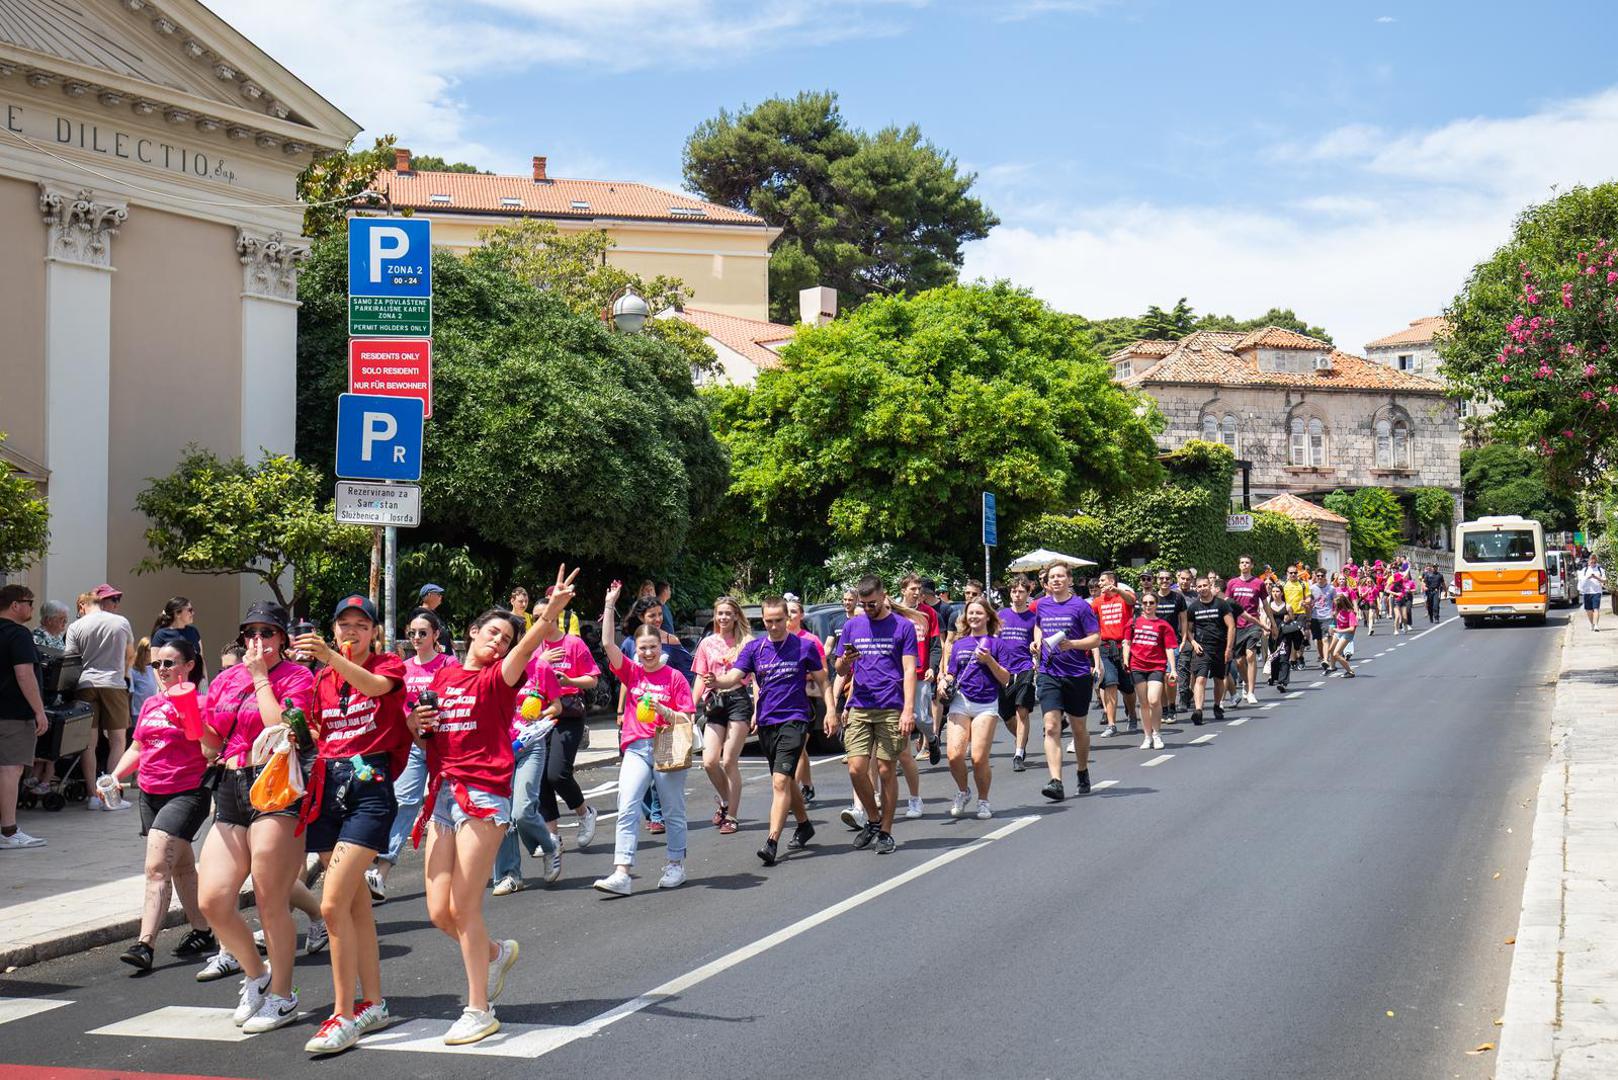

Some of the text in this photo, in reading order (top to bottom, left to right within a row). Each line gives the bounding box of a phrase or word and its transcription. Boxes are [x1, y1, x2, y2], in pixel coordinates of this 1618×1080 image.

[369, 226, 410, 283] P
[387, 265, 423, 275] ZONA 2
[407, 277, 418, 285] 24
[385, 298, 427, 306] POVLAŠTENE
[354, 305, 402, 313] PARKIRALIŠNE
[379, 324, 409, 332] HOLDERS
[360, 352, 420, 360] RESIDENTS ONLY
[361, 367, 419, 375] SOLO RESIDENTI
[370, 380, 386, 389] FÜR
[386, 382, 427, 390] BEWOHNER
[361, 411, 398, 462] P
[393, 445, 406, 463] R
[347, 486, 408, 498] Rezervirano za
[357, 498, 399, 510] Samstan
